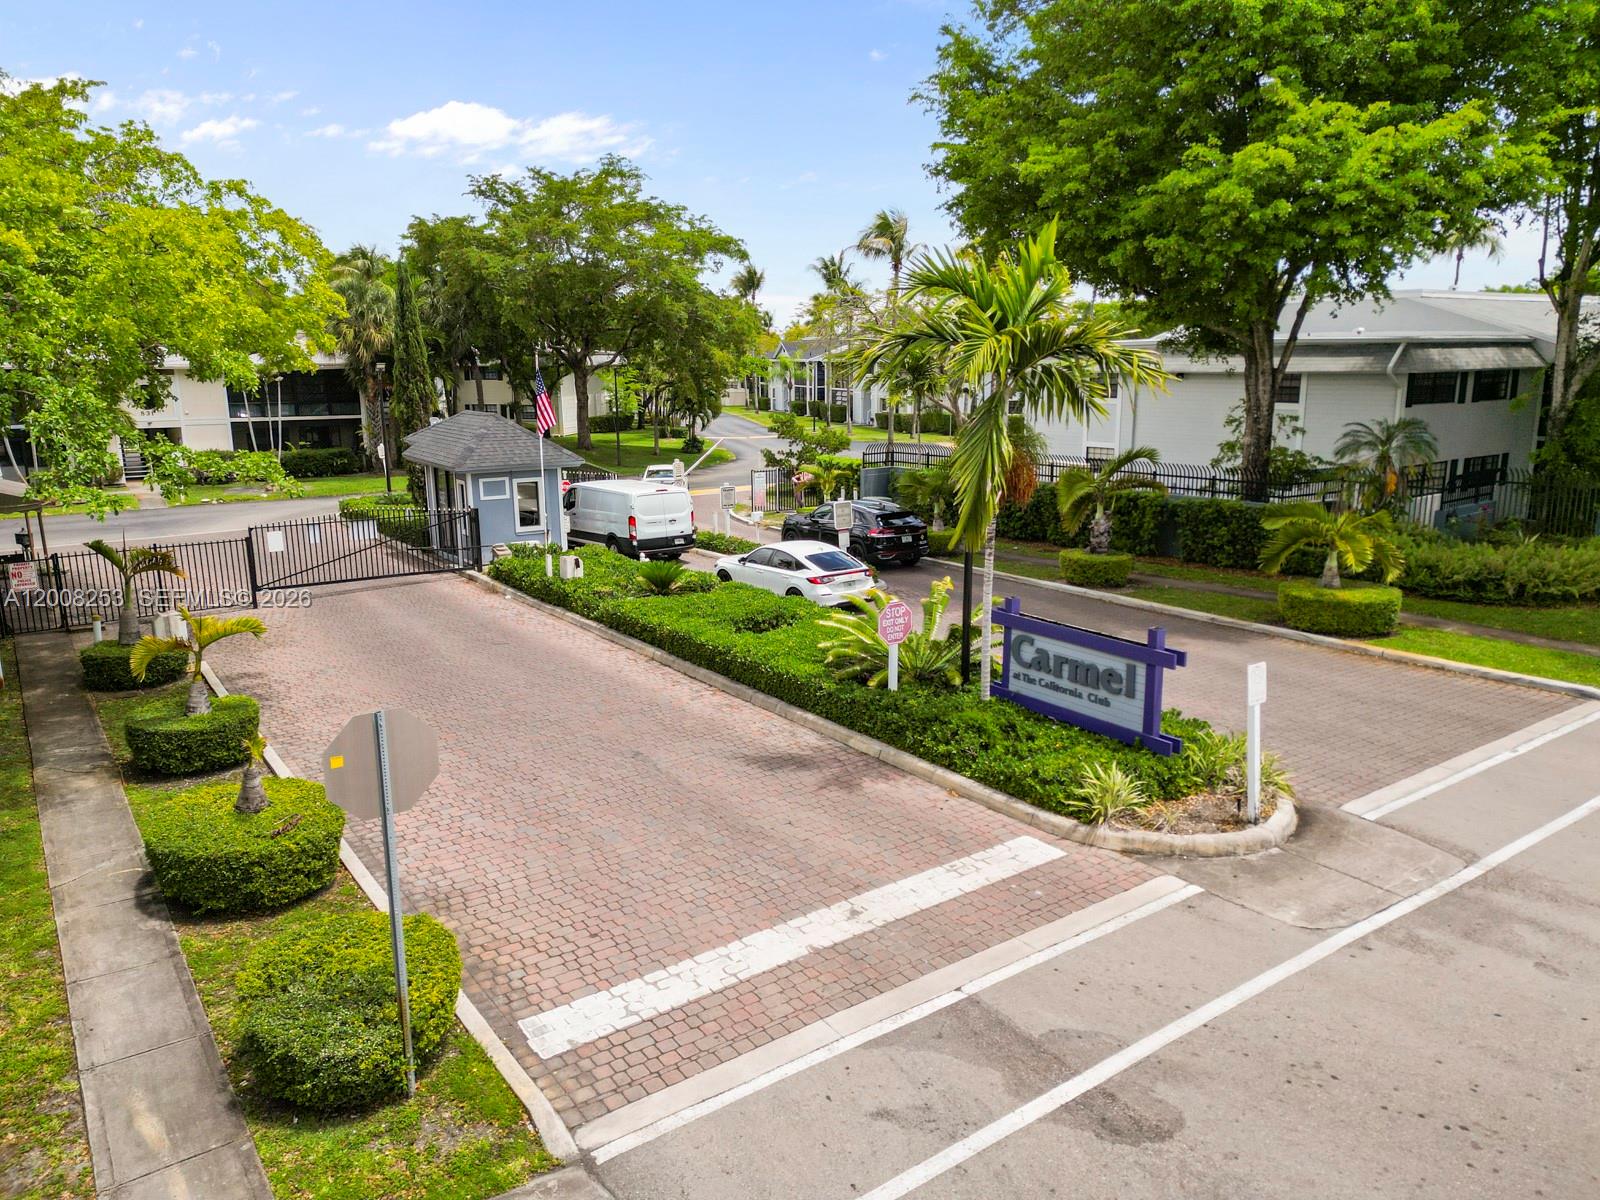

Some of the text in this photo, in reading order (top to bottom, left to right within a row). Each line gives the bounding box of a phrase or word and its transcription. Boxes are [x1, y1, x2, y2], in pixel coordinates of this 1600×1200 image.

[11, 571, 23, 579] NO
[886, 606, 906, 618] STOP
[883, 616, 909, 627] EXIT ONLY
[887, 632, 904, 640] ENTER
[1012, 634, 1136, 699] Carmel
[1013, 672, 1111, 708] at The California Club
